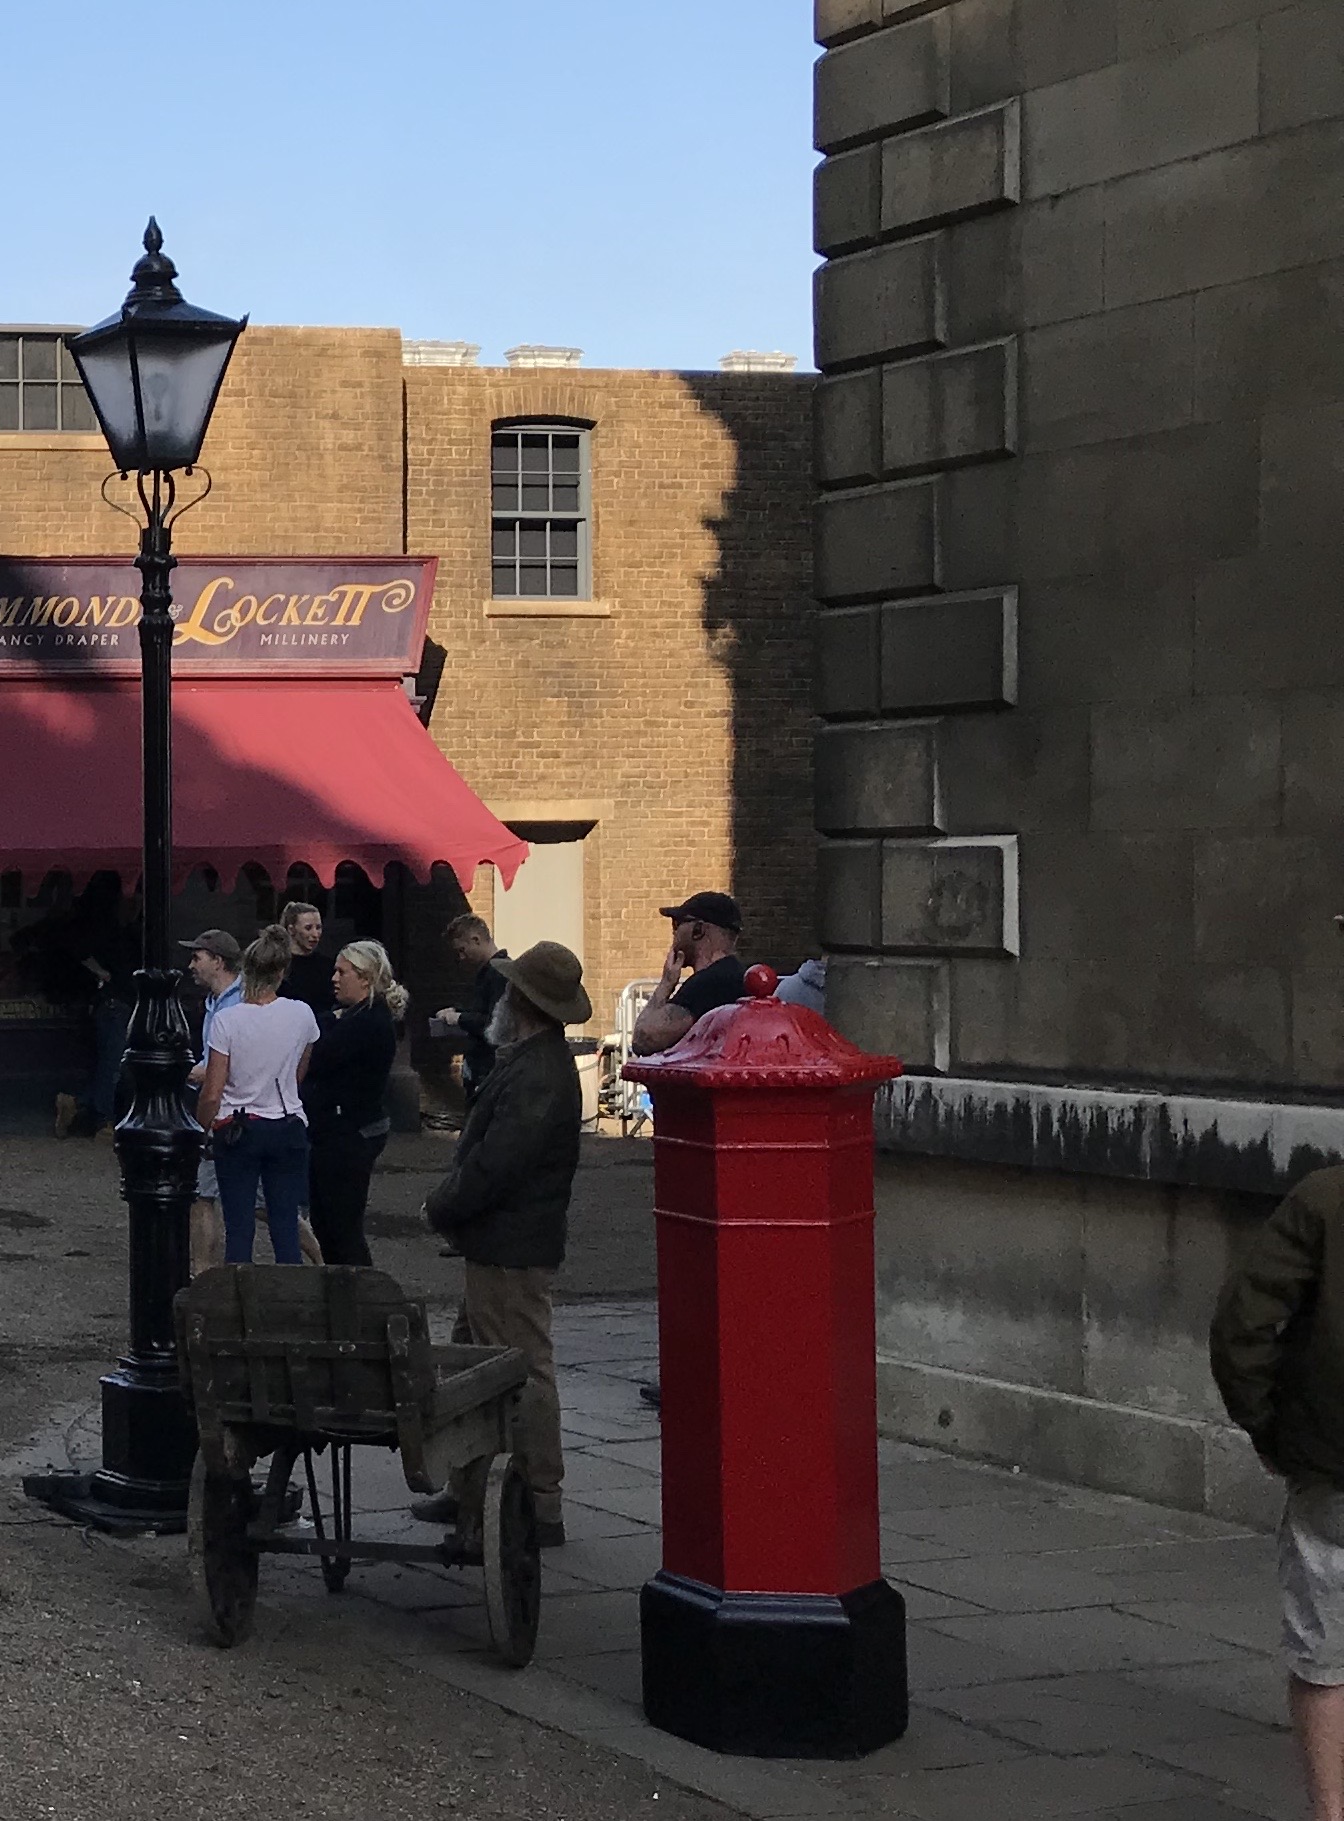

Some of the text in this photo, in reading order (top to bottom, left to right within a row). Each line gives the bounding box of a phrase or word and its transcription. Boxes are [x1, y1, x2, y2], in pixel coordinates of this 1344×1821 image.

[172, 576, 416, 647] LOCKETT
[55, 633, 120, 647] DRAPER
[260, 633, 350, 646] MILLINERY
